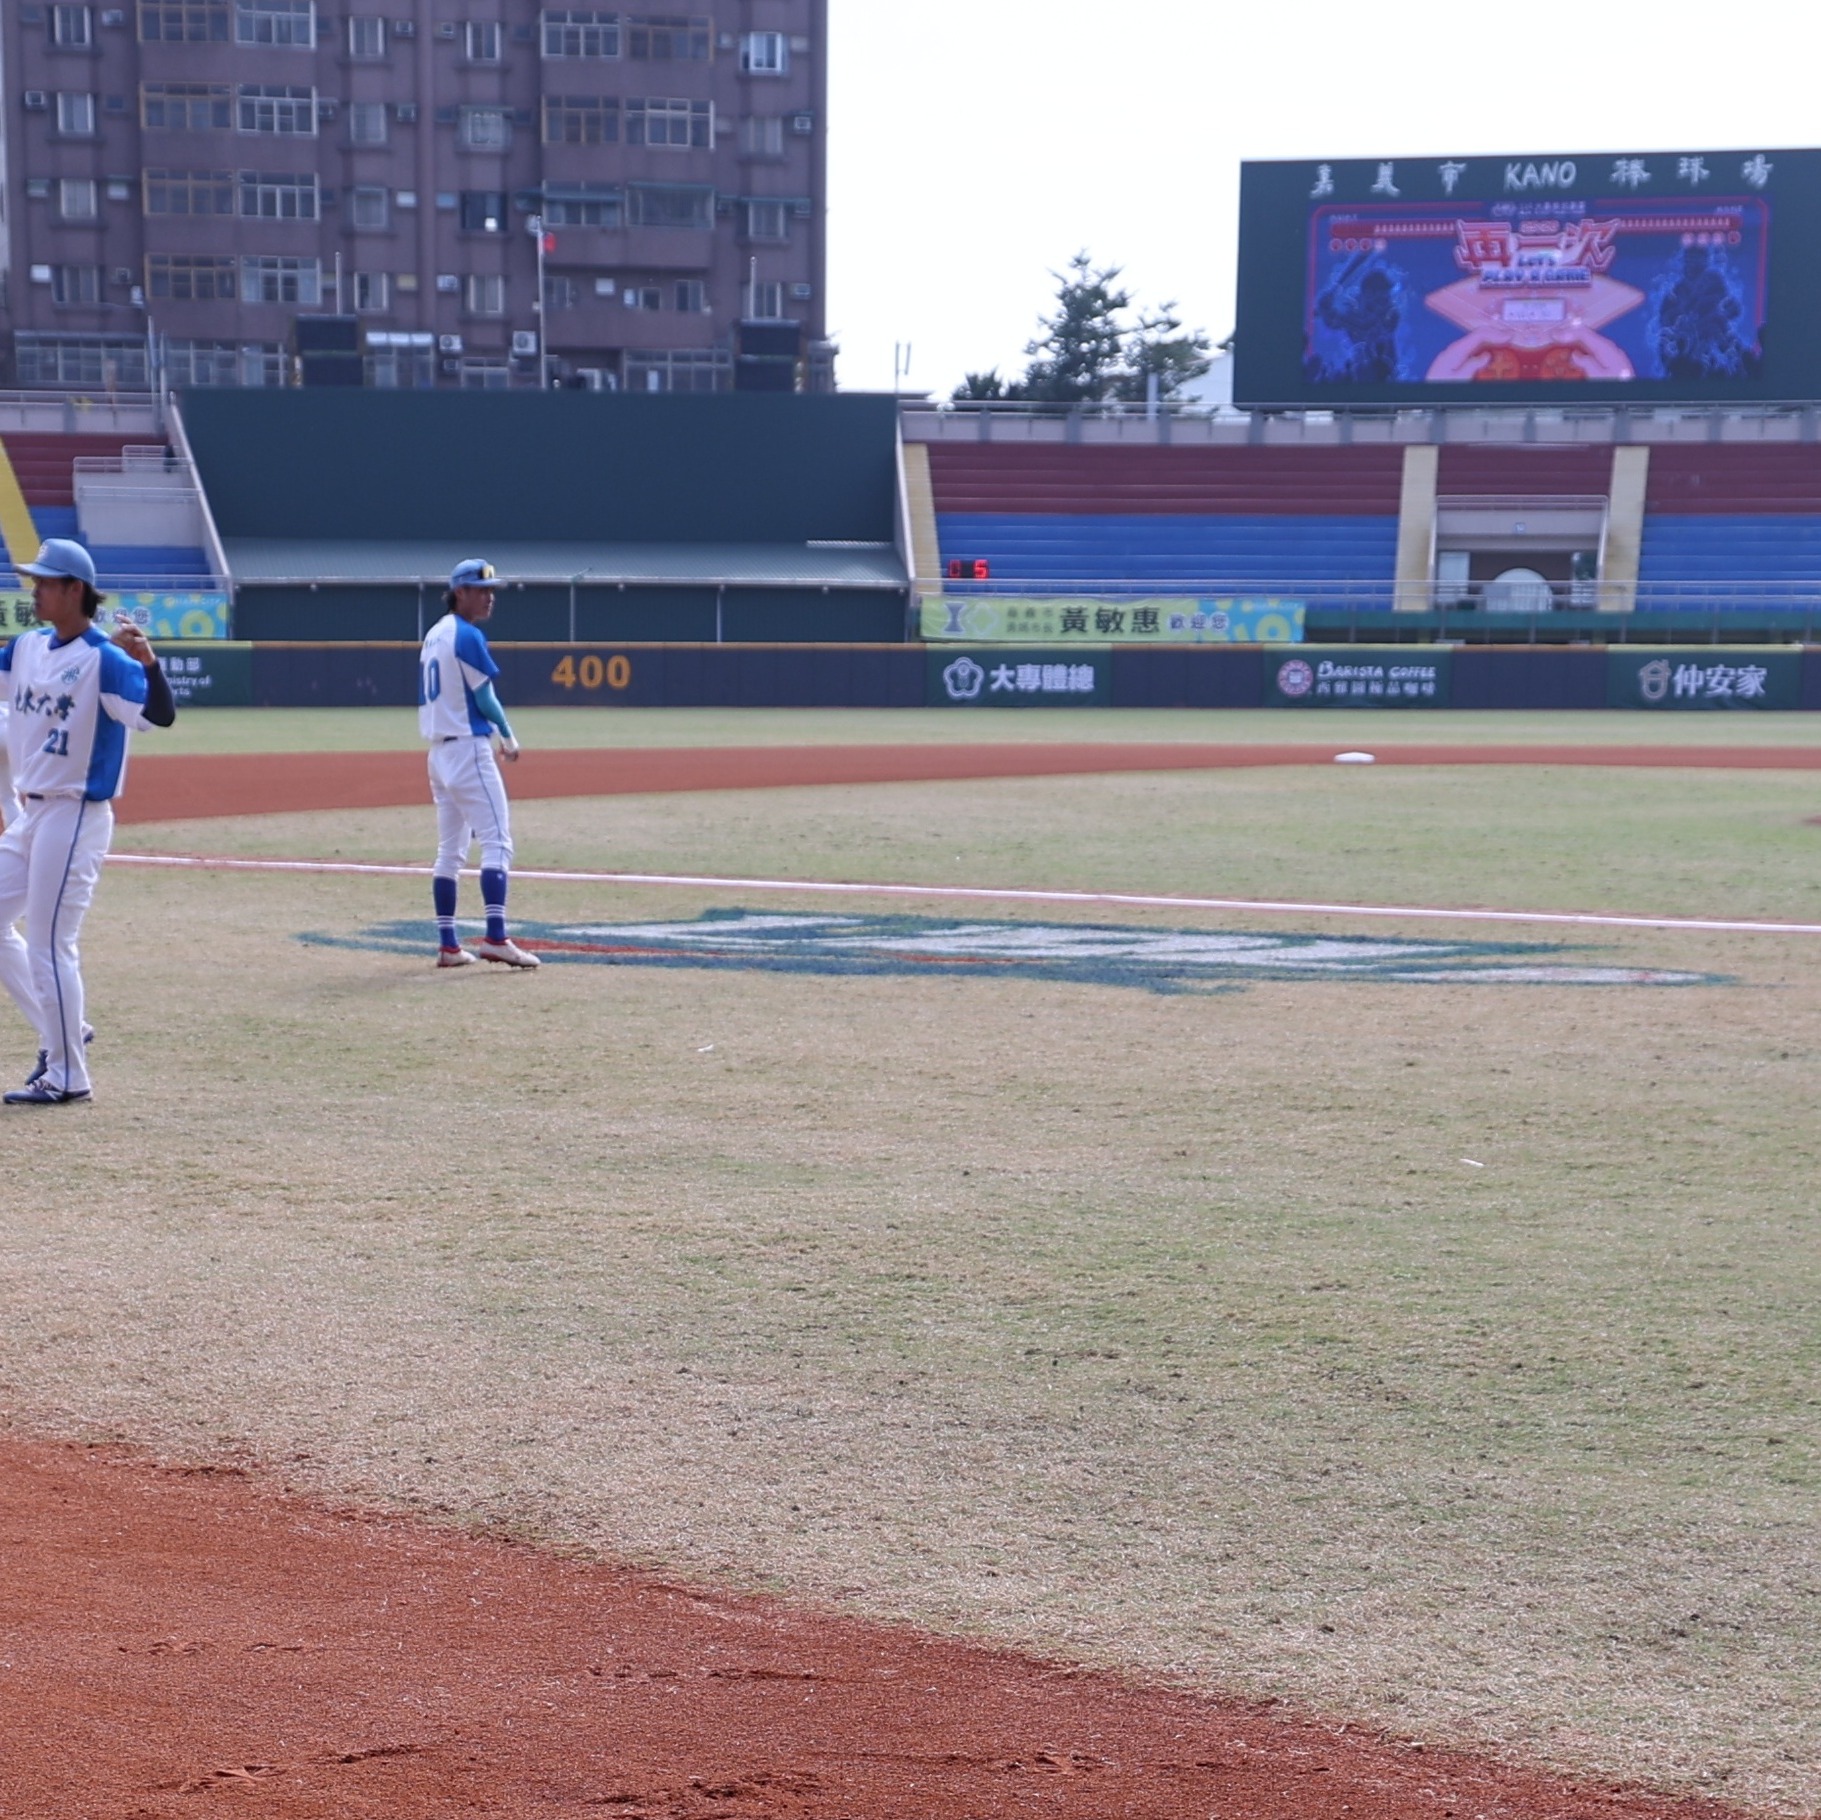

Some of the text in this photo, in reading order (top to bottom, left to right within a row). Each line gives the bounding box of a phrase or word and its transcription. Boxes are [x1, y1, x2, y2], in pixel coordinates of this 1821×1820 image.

[1310, 153, 1774, 198] 嘉義市 KANO 棒球場
[1060, 605, 1161, 634] 黃敏惠
[551, 655, 631, 689] 400
[990, 663, 1095, 693] 大專體總
[1389, 666, 1436, 678] COFFEE
[1673, 664, 1767, 697] 仲安家
[43, 728, 69, 756] 21
